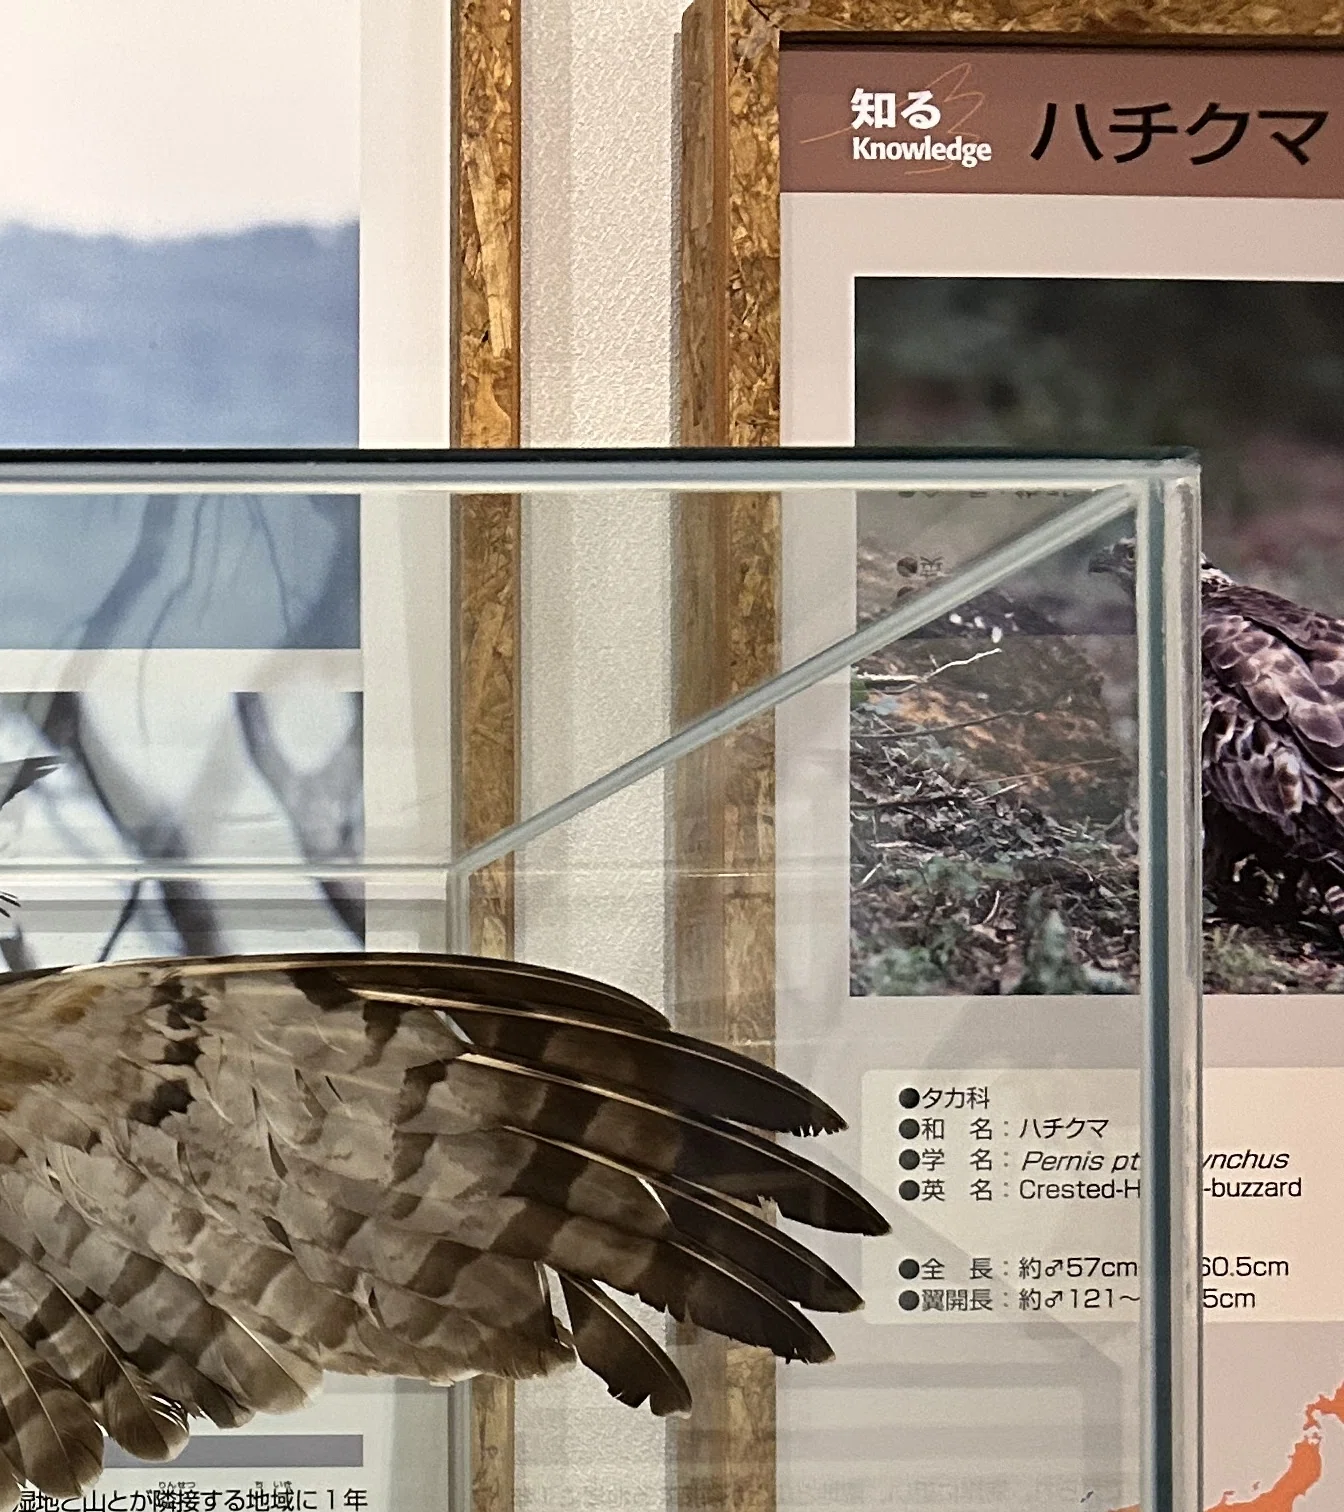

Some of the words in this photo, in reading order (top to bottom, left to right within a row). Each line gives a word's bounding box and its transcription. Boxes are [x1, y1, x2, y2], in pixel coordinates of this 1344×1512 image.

[851, 87, 941, 130] 知る
[1030, 101, 1329, 166] ハチクマ
[853, 136, 992, 169] Knowledge
[921, 1086, 990, 1110] タカ科
[1021, 1150, 1104, 1172] Pernis
